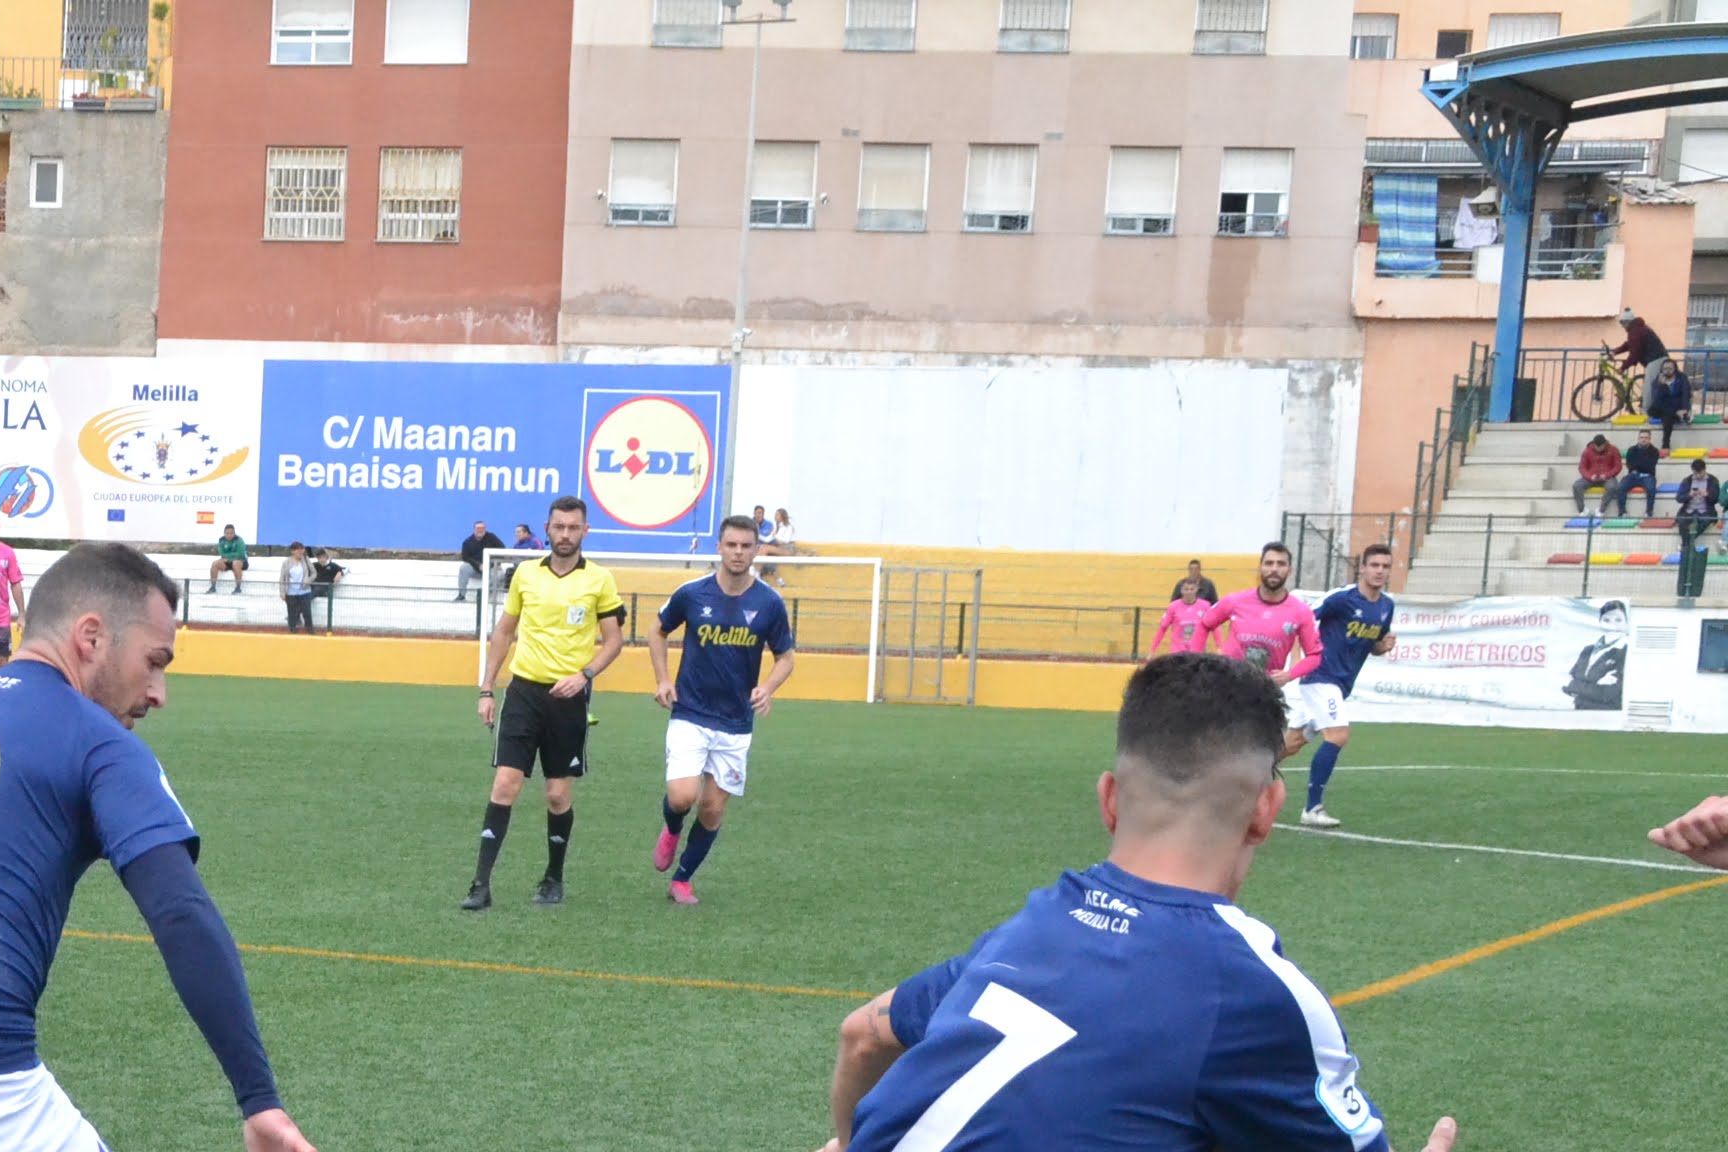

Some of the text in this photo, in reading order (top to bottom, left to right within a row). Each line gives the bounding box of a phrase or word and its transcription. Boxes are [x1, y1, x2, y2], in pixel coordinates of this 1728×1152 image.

[132, 384, 199, 401] Melilla
[322, 415, 517, 452] C/ Maanan
[277, 454, 560, 494] Benaisa Mimun
[93, 492, 233, 504] CIUDAD EUROPEA DEL DEPORTE
[1415, 613, 1463, 629] mejor
[697, 624, 758, 647] Melilla
[1084, 889, 1144, 917] KELME
